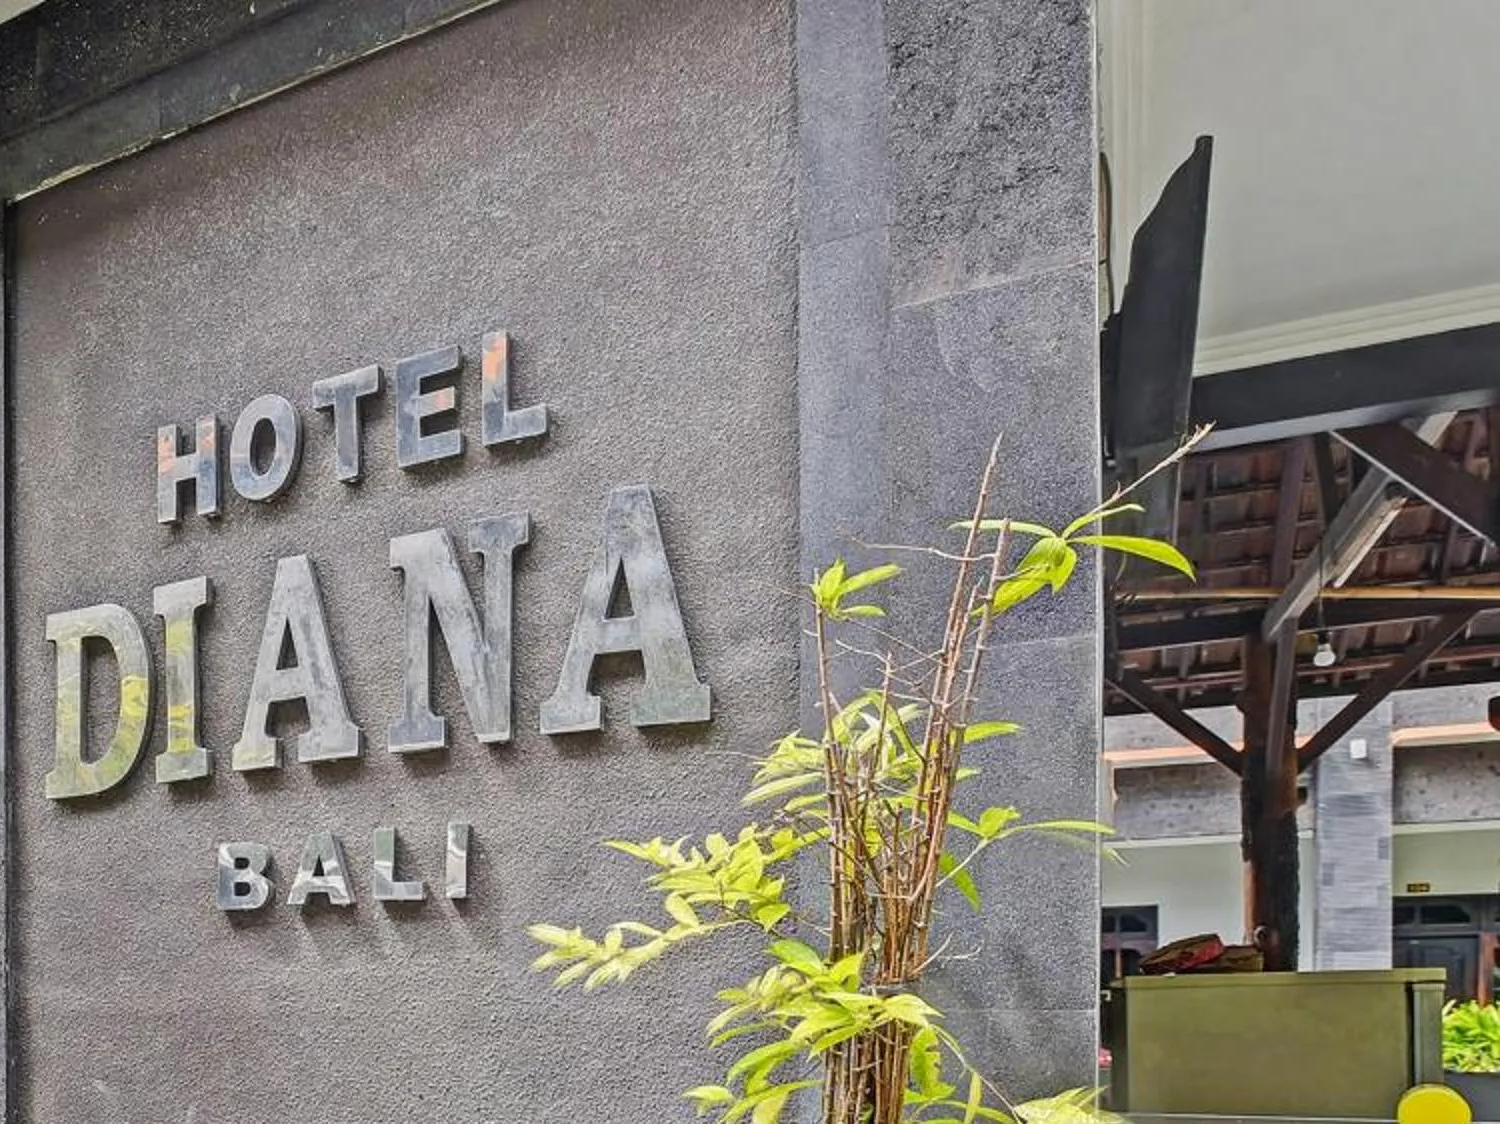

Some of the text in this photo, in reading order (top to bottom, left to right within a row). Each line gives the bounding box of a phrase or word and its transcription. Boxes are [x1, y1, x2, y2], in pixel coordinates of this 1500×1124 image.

[156, 331, 549, 524] HOTEL
[45, 484, 711, 800] DIANA
[217, 822, 471, 911] BALI
